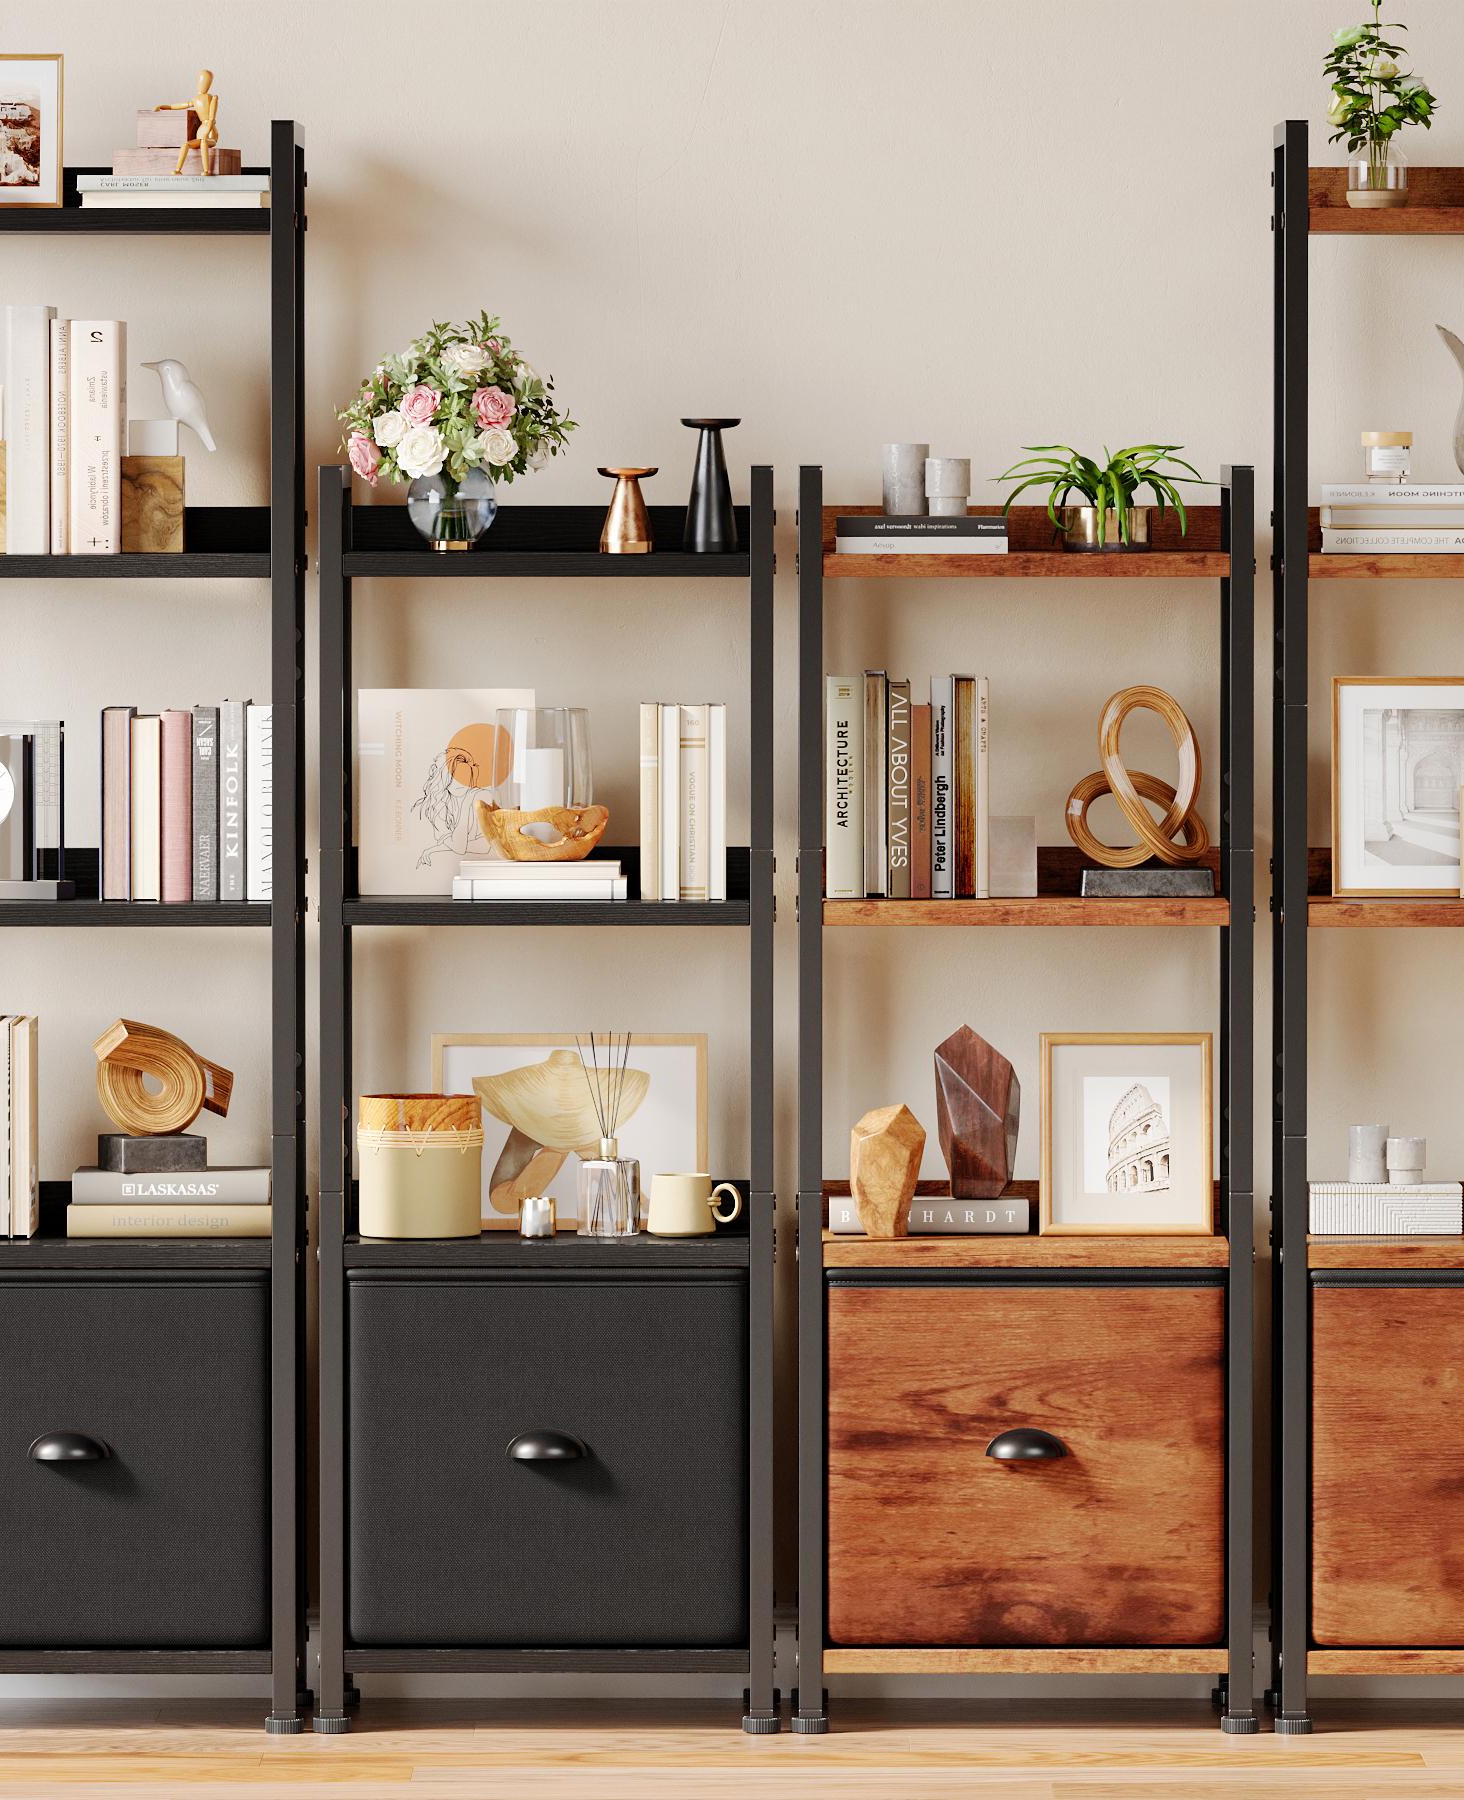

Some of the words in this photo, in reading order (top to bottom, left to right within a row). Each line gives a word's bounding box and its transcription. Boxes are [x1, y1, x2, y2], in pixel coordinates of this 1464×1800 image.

[891, 692, 908, 730] ALL
[394, 759, 402, 789] MOON
[688, 771, 696, 801] VOGUE
[836, 720, 849, 828] ARCHITECTURE
[891, 736, 908, 809] ABOUT
[226, 744, 239, 859] KINFOLK
[688, 803, 696, 817] ON
[934, 775, 949, 837] Lindbergh
[688, 818, 696, 864] CHRISTIAN
[891, 817, 908, 868] YVES
[934, 840, 946, 872] Peter
[199, 834, 211, 896] NAERVAER
[137, 1183, 219, 1196] LASKASAS
[112, 1214, 173, 1227] interior
[177, 1214, 230, 1230] design
[840, 1210, 1016, 1223] BHARDT
